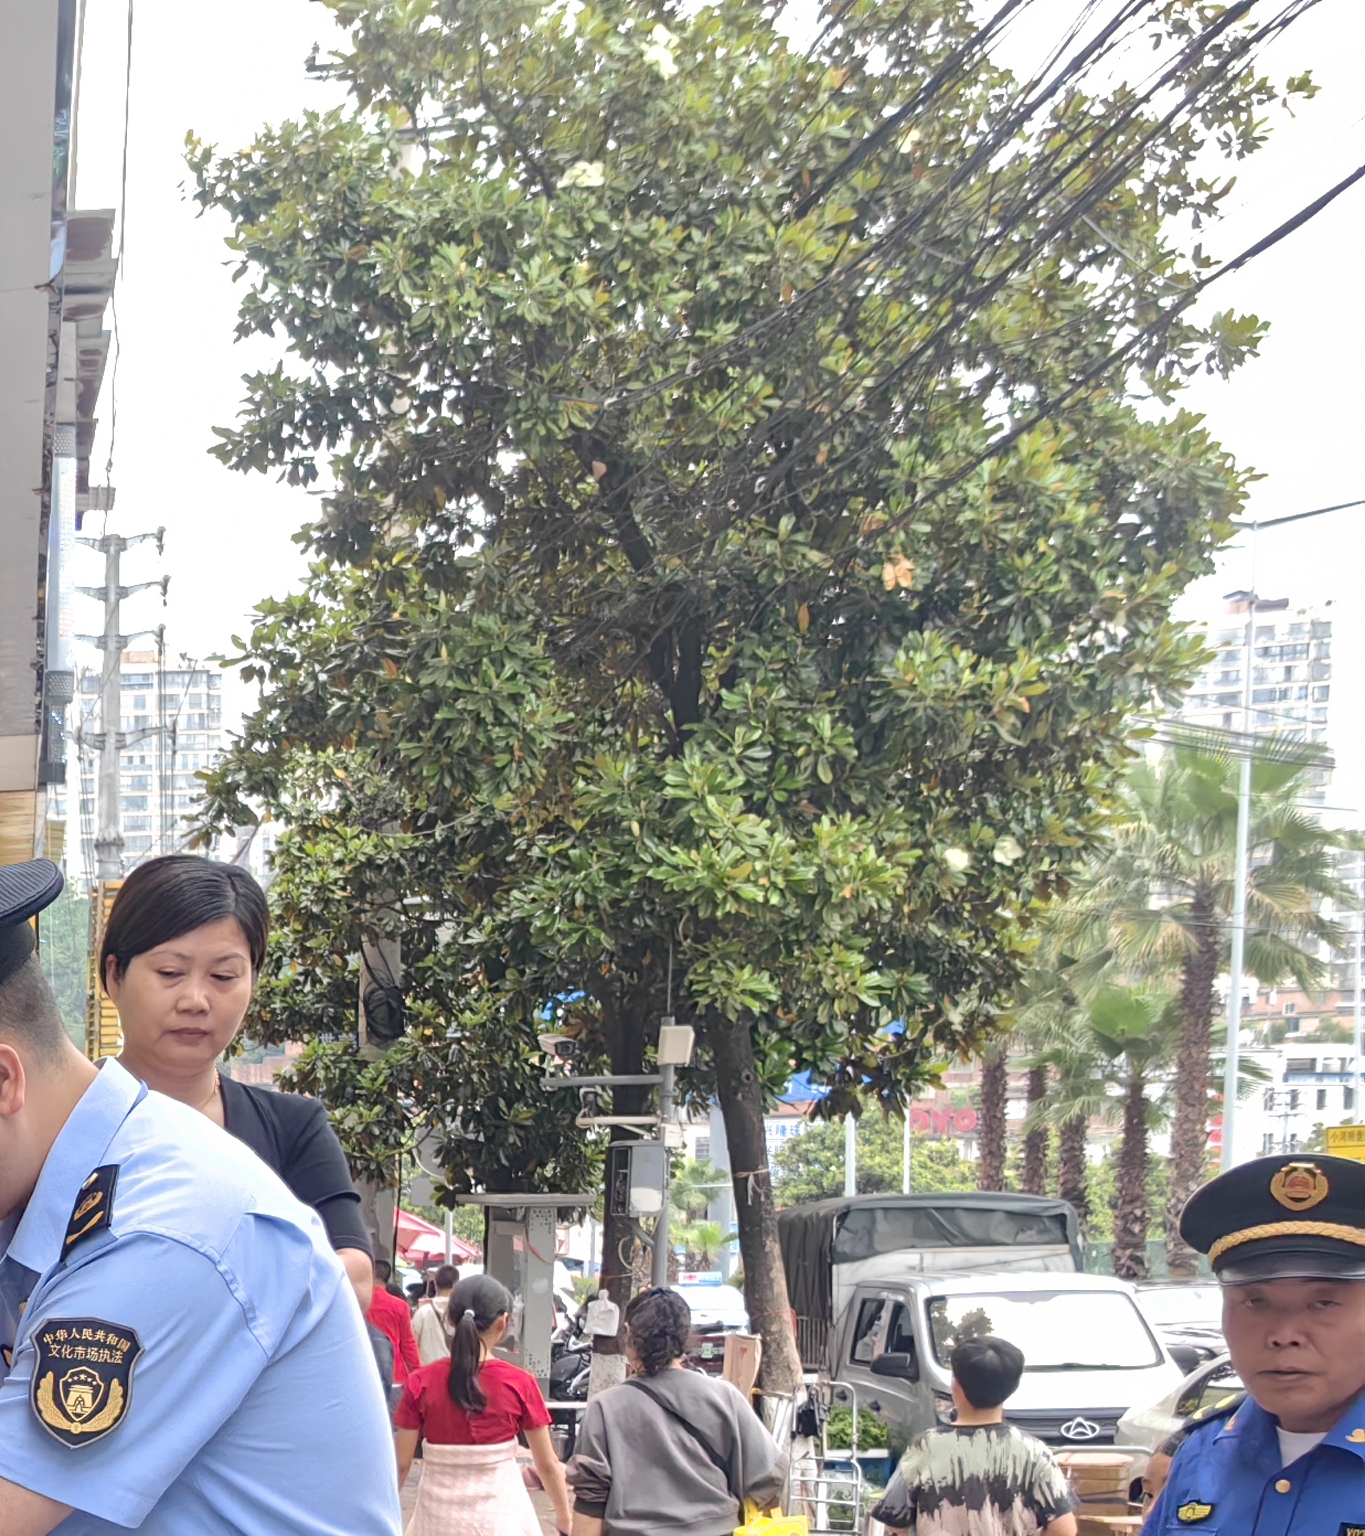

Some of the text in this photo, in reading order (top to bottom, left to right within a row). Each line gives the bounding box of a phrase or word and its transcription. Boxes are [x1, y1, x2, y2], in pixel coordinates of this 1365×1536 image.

[43, 1327, 131, 1353] 中华人民共和国
[47, 1343, 125, 1364] 文化市场执法
